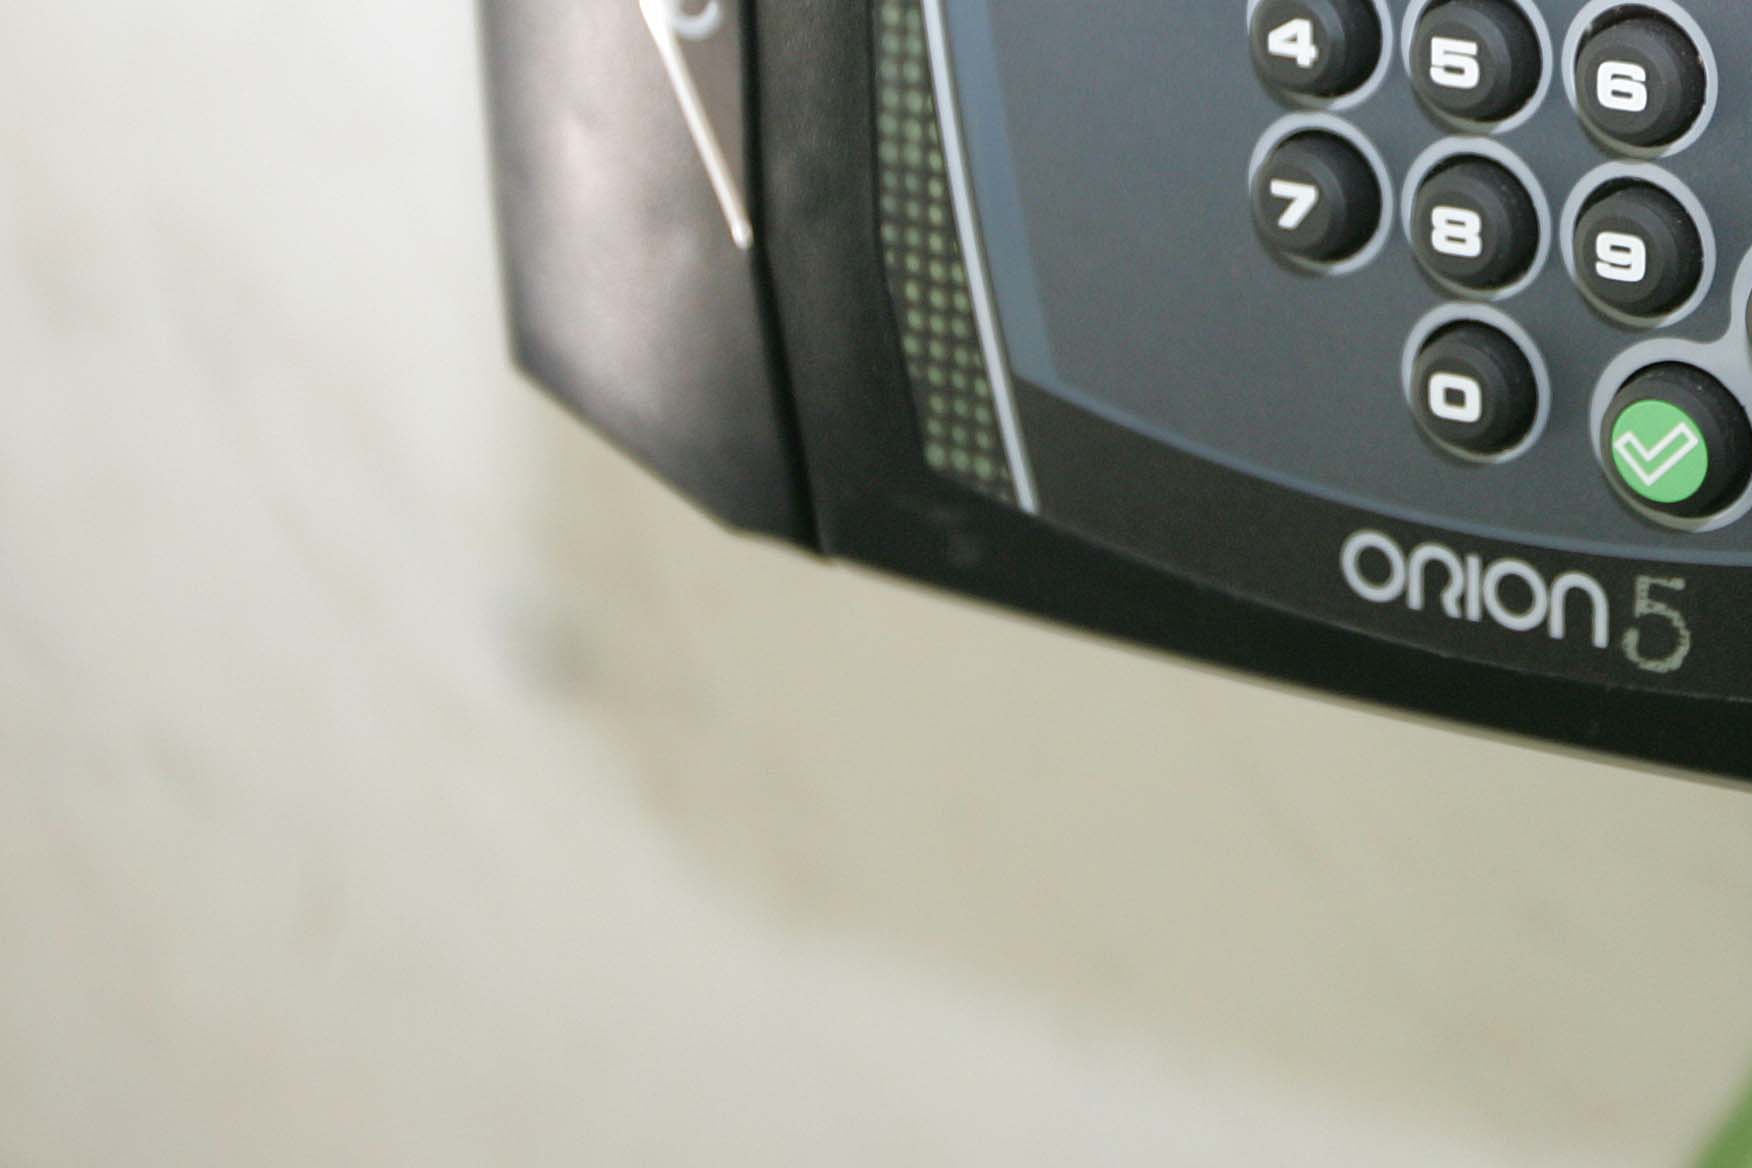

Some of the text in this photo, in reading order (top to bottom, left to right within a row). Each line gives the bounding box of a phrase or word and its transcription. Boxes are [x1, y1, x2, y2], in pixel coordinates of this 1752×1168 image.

[1267, 18, 1318, 69] 4
[1429, 36, 1480, 89] 5
[1596, 61, 1648, 113] 6
[1269, 179, 1318, 229] 7
[1430, 206, 1483, 258] 8
[1595, 231, 1647, 282] 9
[1428, 372, 1482, 423] 0
[1622, 575, 1691, 674] 5
